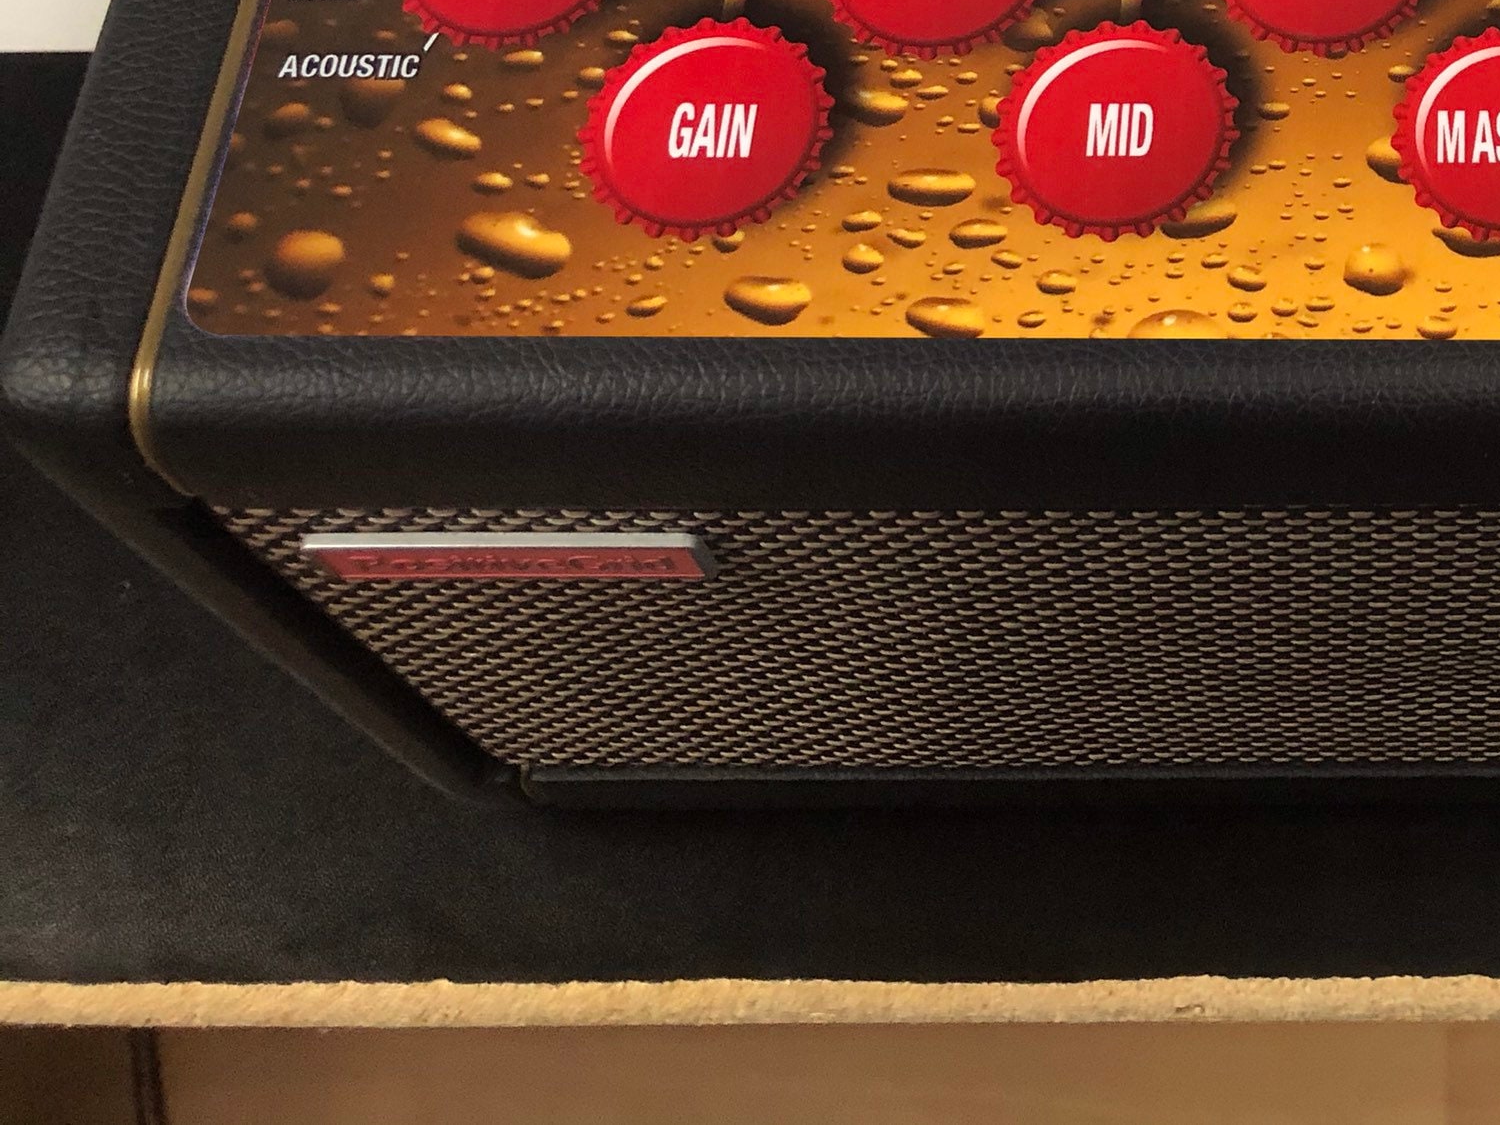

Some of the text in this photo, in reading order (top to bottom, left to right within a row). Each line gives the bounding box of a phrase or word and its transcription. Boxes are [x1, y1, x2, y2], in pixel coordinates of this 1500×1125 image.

[278, 53, 420, 80] ACOUSTIC
[667, 101, 758, 160] GAIN
[1085, 102, 1154, 158] MID
